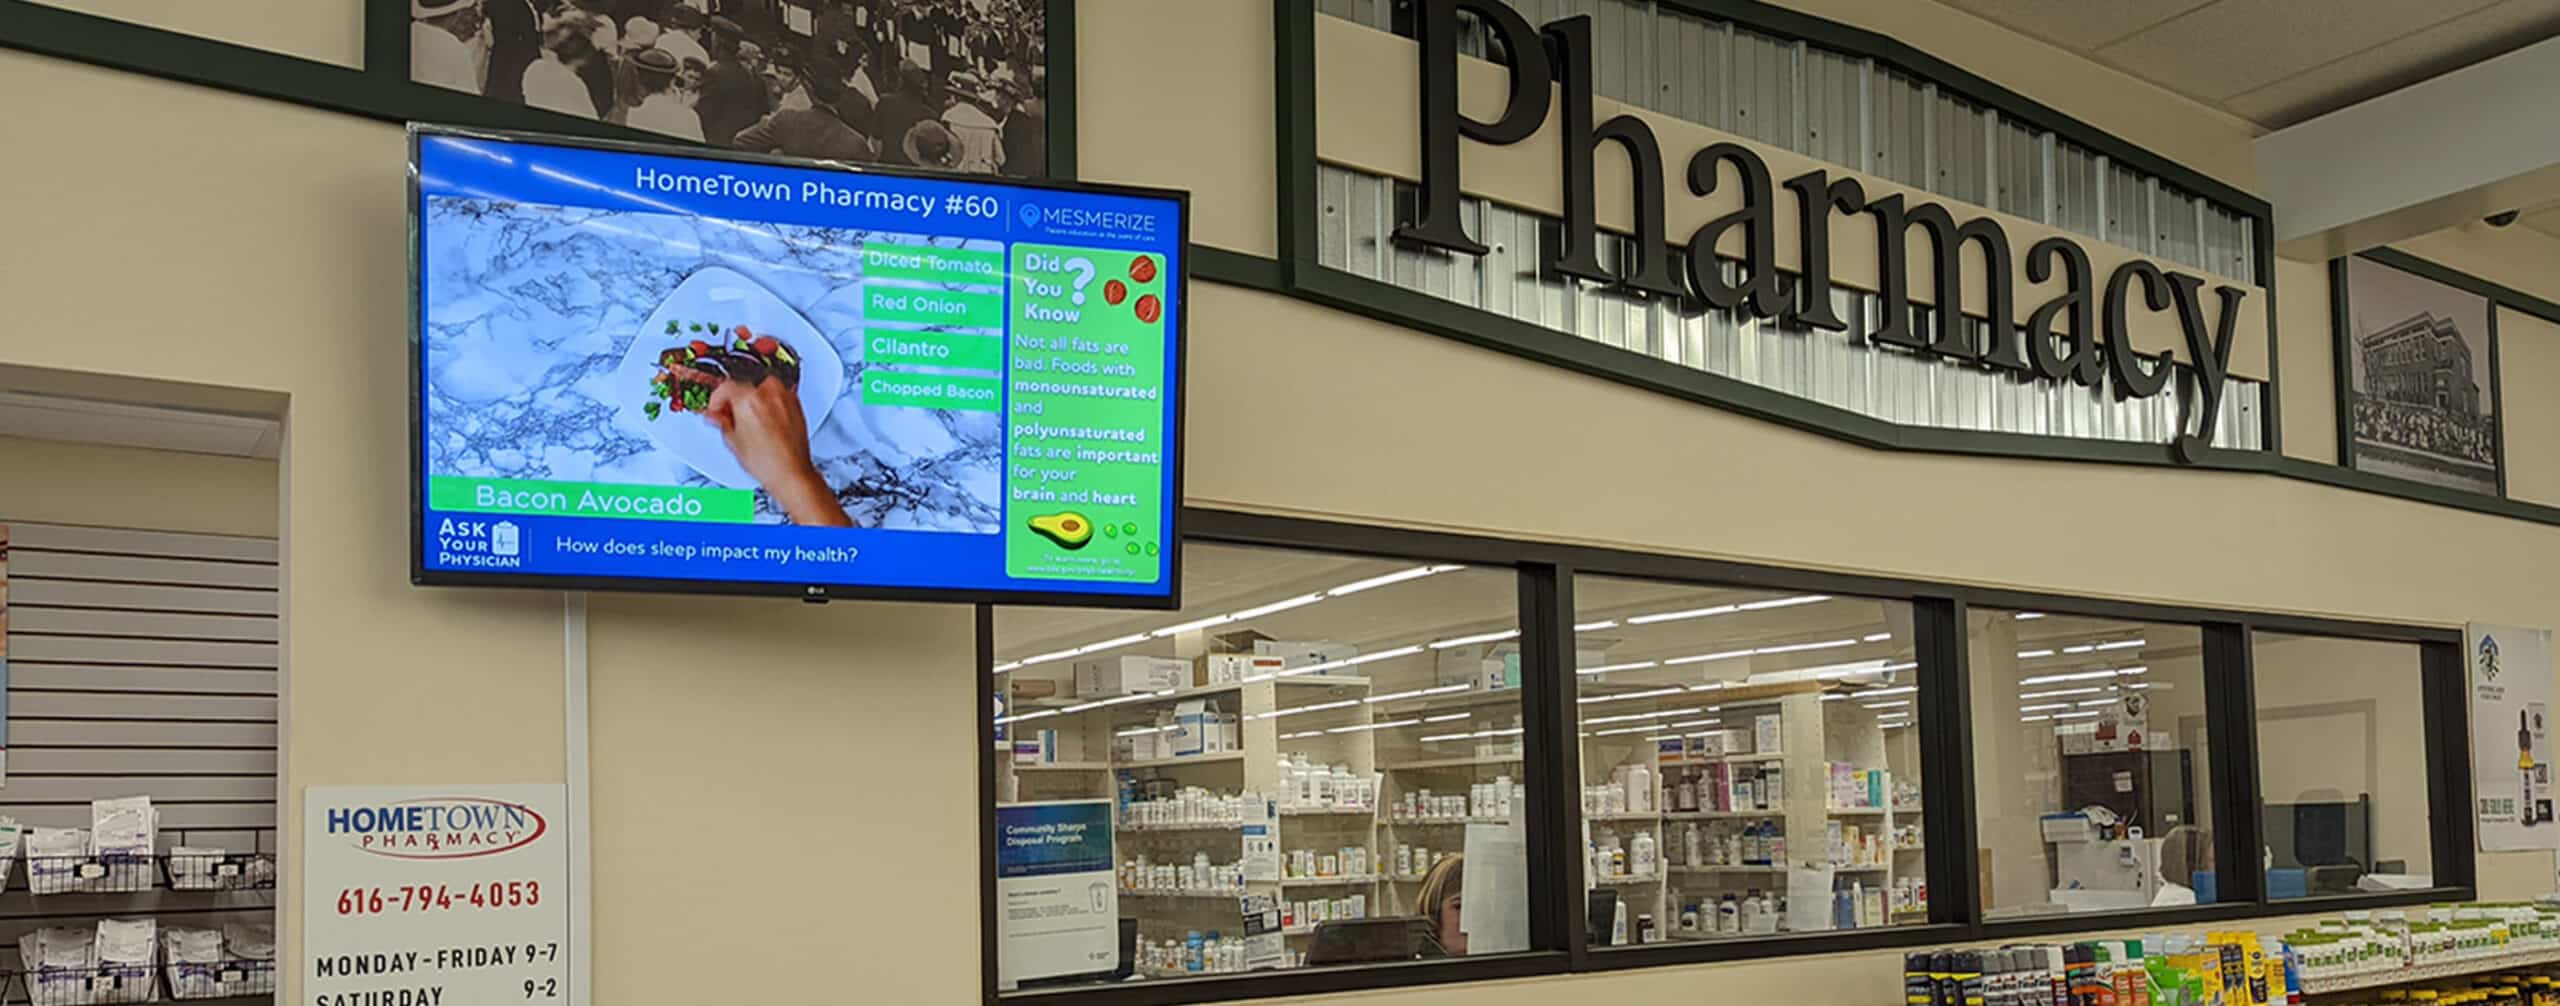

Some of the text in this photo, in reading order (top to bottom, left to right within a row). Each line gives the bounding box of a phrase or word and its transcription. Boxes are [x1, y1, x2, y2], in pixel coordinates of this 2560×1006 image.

[636, 166, 998, 219] HomeTown Pharmacy #60
[1043, 207, 1155, 232] MESMERIZE
[1393, 0, 2245, 463] Pharmacy
[869, 250, 993, 275] Diced Tomato
[1025, 252, 1060, 273] Did
[1024, 277, 1062, 297] You
[872, 293, 967, 316] Red Onion
[1025, 303, 1081, 323] Know
[871, 336, 950, 359] Cilantro
[1015, 333, 1130, 355] Not all fats are
[1014, 356, 1136, 377] bad. Foods with
[870, 379, 995, 402] Chopped Bacon
[1014, 379, 1157, 400] monounsaturated
[1014, 400, 1043, 414] and
[1013, 421, 1145, 442] polyunsaturated
[1013, 442, 1158, 466] fats are important
[1013, 463, 1077, 483] for your
[475, 483, 703, 518] Bacon Avocado
[1012, 485, 1137, 506] brain and heart
[555, 535, 858, 568] How does sleep impact my health?
[328, 804, 526, 834] HOMETOWN
[1006, 825, 1056, 836] Community
[337, 880, 540, 915] 616-794-4053
[317, 943, 557, 977] MONDAY-FRIDAY 9-7
[316, 978, 557, 1006] SATURDAY 9-2
